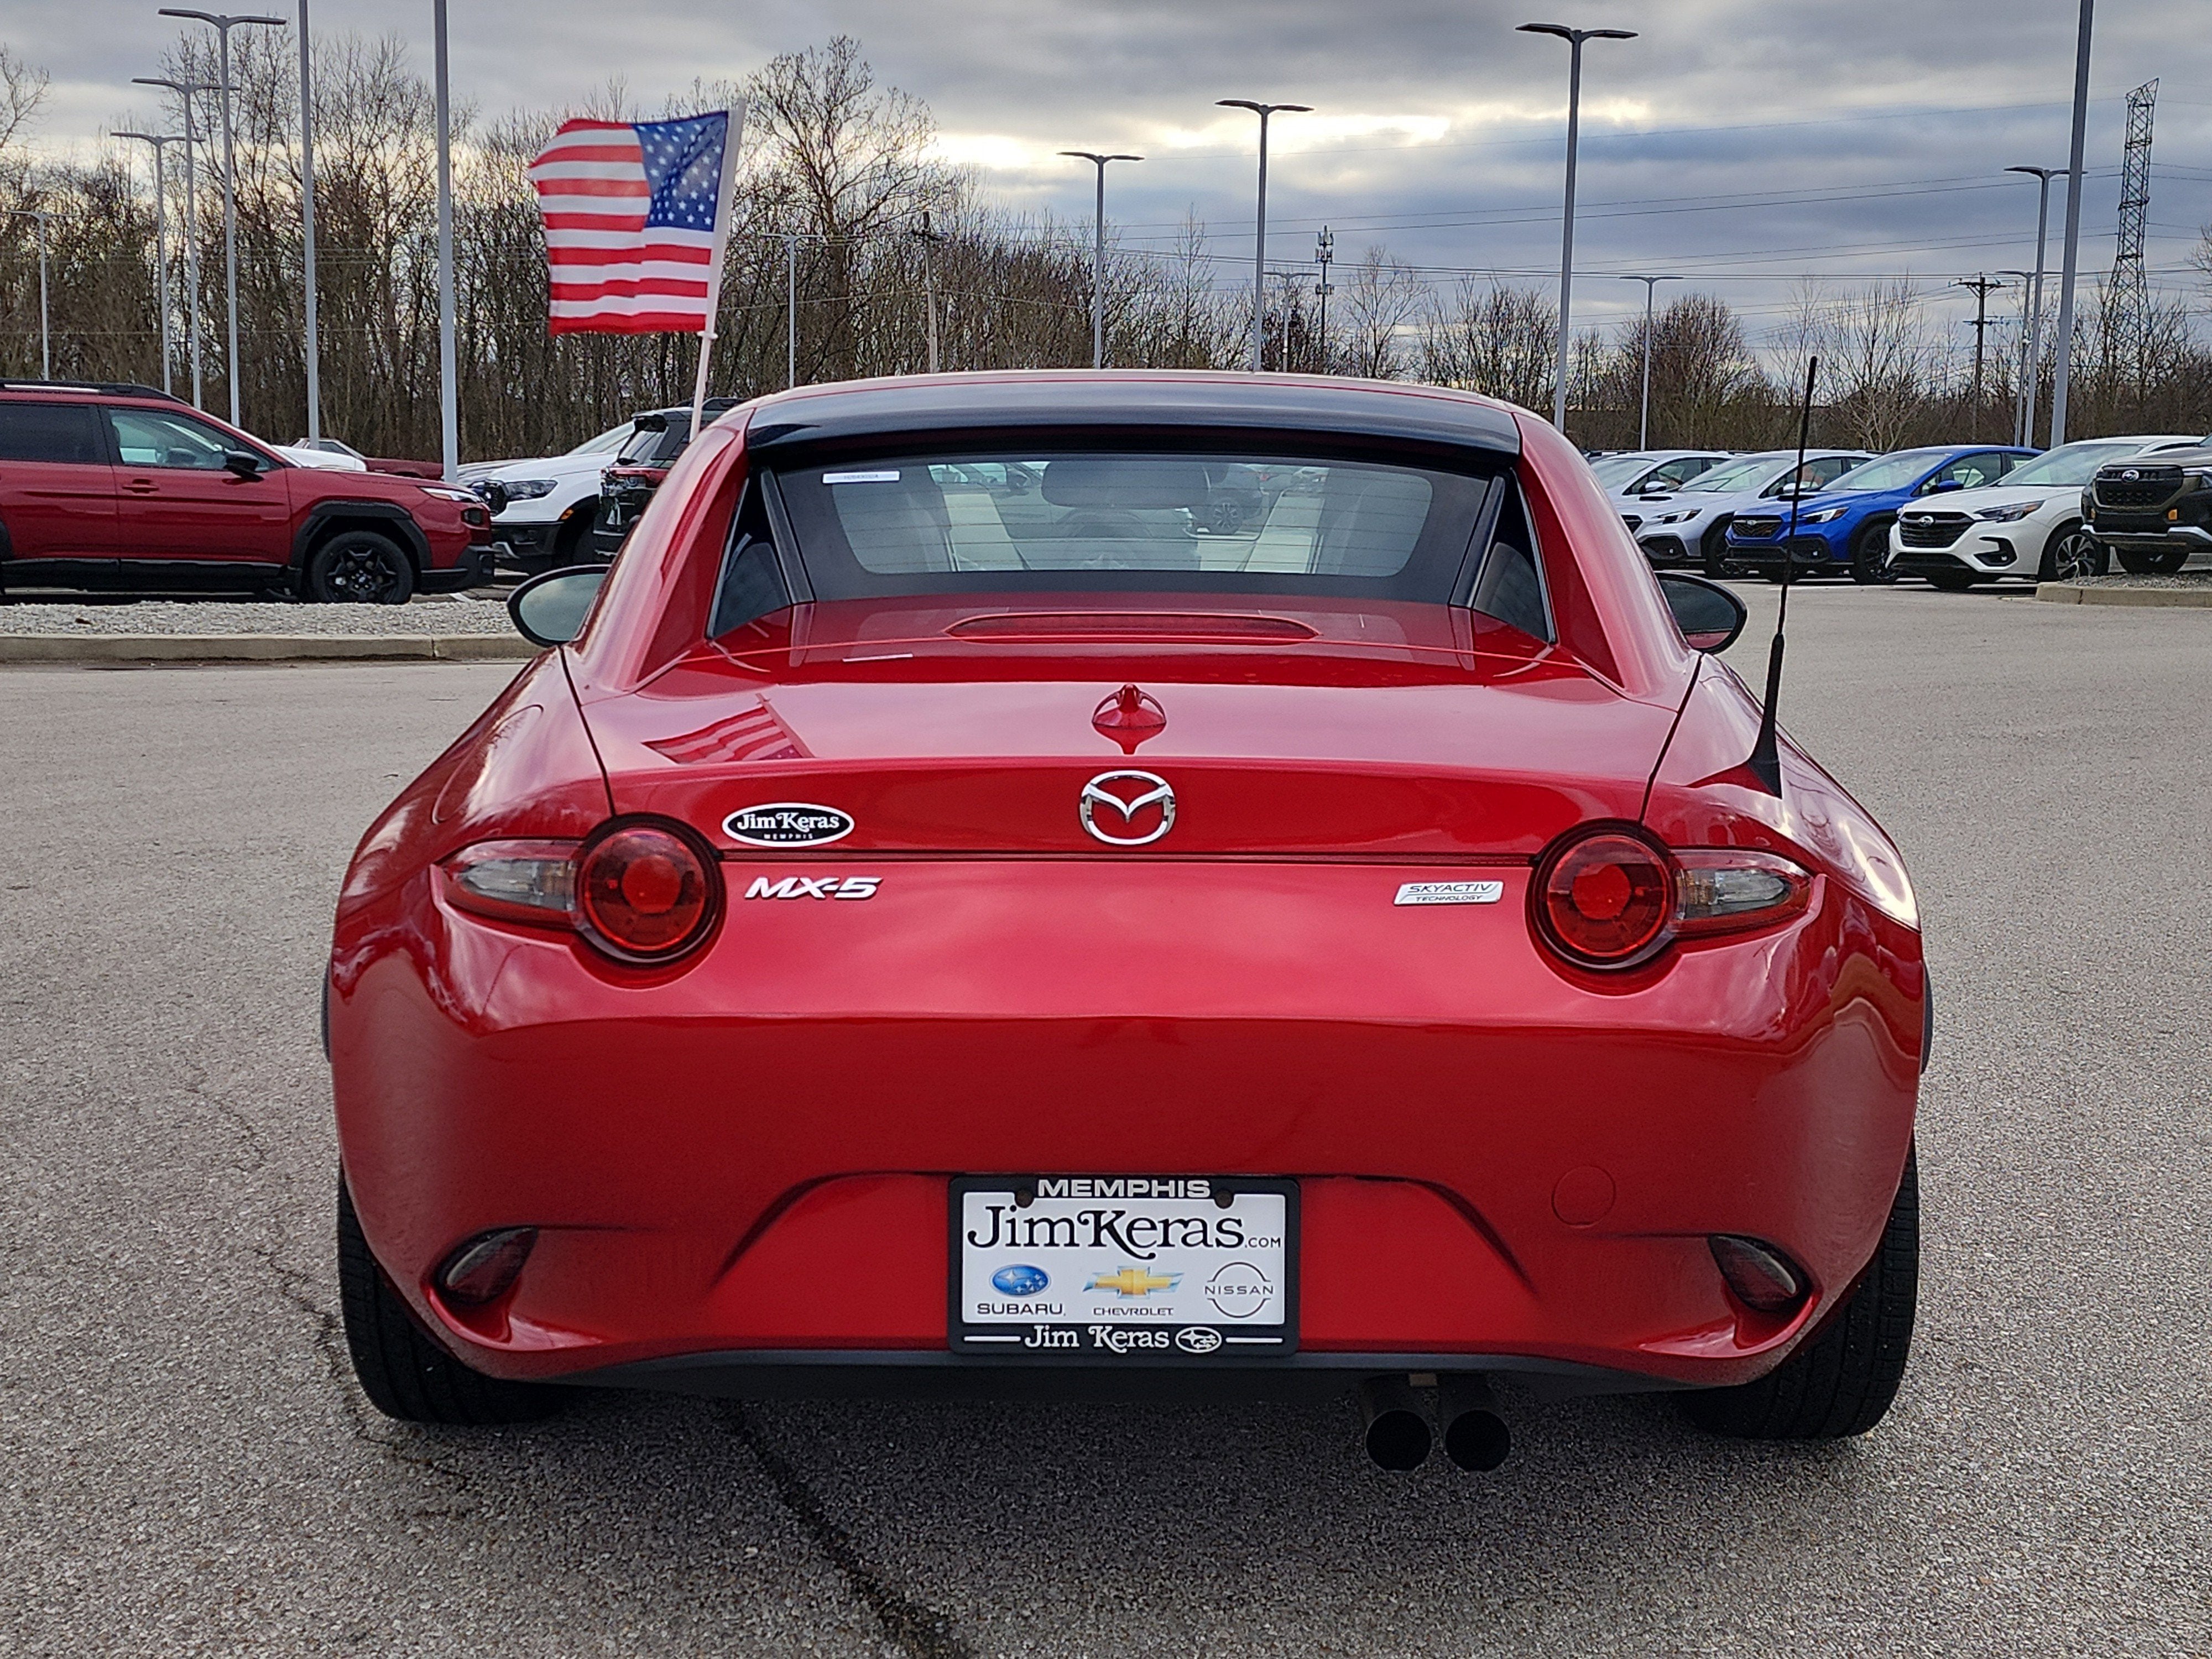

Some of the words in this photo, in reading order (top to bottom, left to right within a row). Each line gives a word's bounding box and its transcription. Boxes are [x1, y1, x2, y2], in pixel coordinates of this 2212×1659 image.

[744, 877, 883, 899] MX-5
[1408, 884, 1493, 893] SKYACTIV
[1038, 1179, 1211, 1198] MEMPHIS
[1204, 1285, 1274, 1295] NISSAN
[977, 1303, 1064, 1316] SUBARU
[1093, 1307, 1174, 1316] CHEVROLET
[1024, 1325, 1079, 1348] Jim
[1088, 1326, 1170, 1353] Keras
